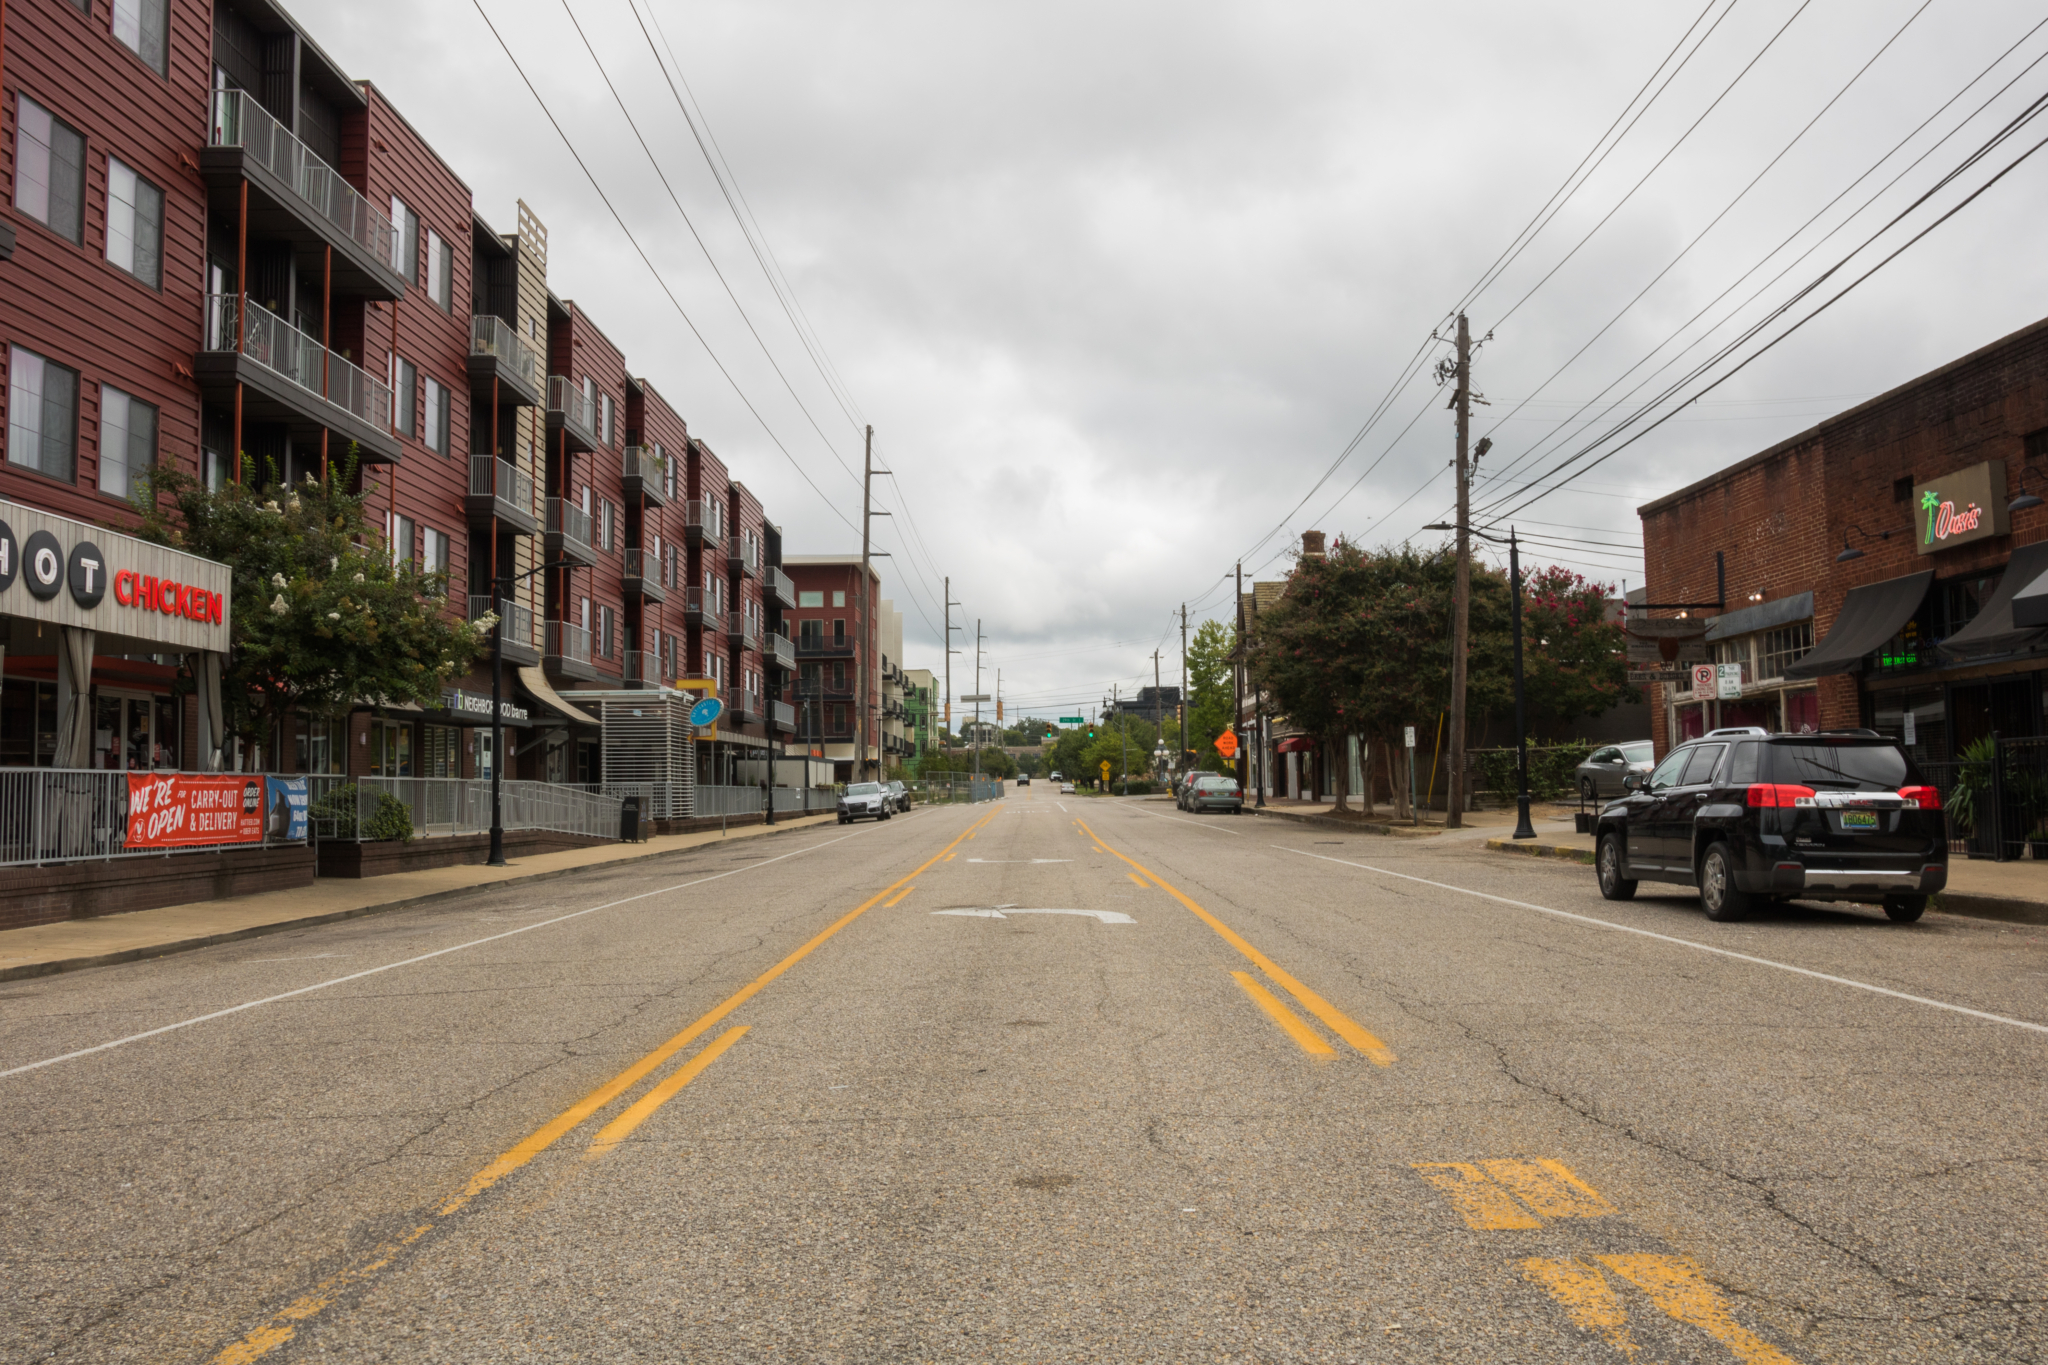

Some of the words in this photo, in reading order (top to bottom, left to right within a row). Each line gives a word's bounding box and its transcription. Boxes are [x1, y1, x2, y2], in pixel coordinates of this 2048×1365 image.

[1935, 501, 1982, 540] Oasis
[114, 568, 223, 625] CHICKEN
[1718, 666, 1724, 676] 2
[511, 703, 528, 721] barre
[129, 778, 176, 817] WE'RE
[191, 789, 239, 809] CARRY-OUT
[242, 797, 260, 808] ONLINE
[243, 787, 260, 798] ORDER
[147, 802, 186, 839] OPEN
[189, 812, 197, 832] &
[199, 811, 238, 832] DELIVERY
[242, 827, 251, 835] UBER
[251, 827, 260, 835] EATS
